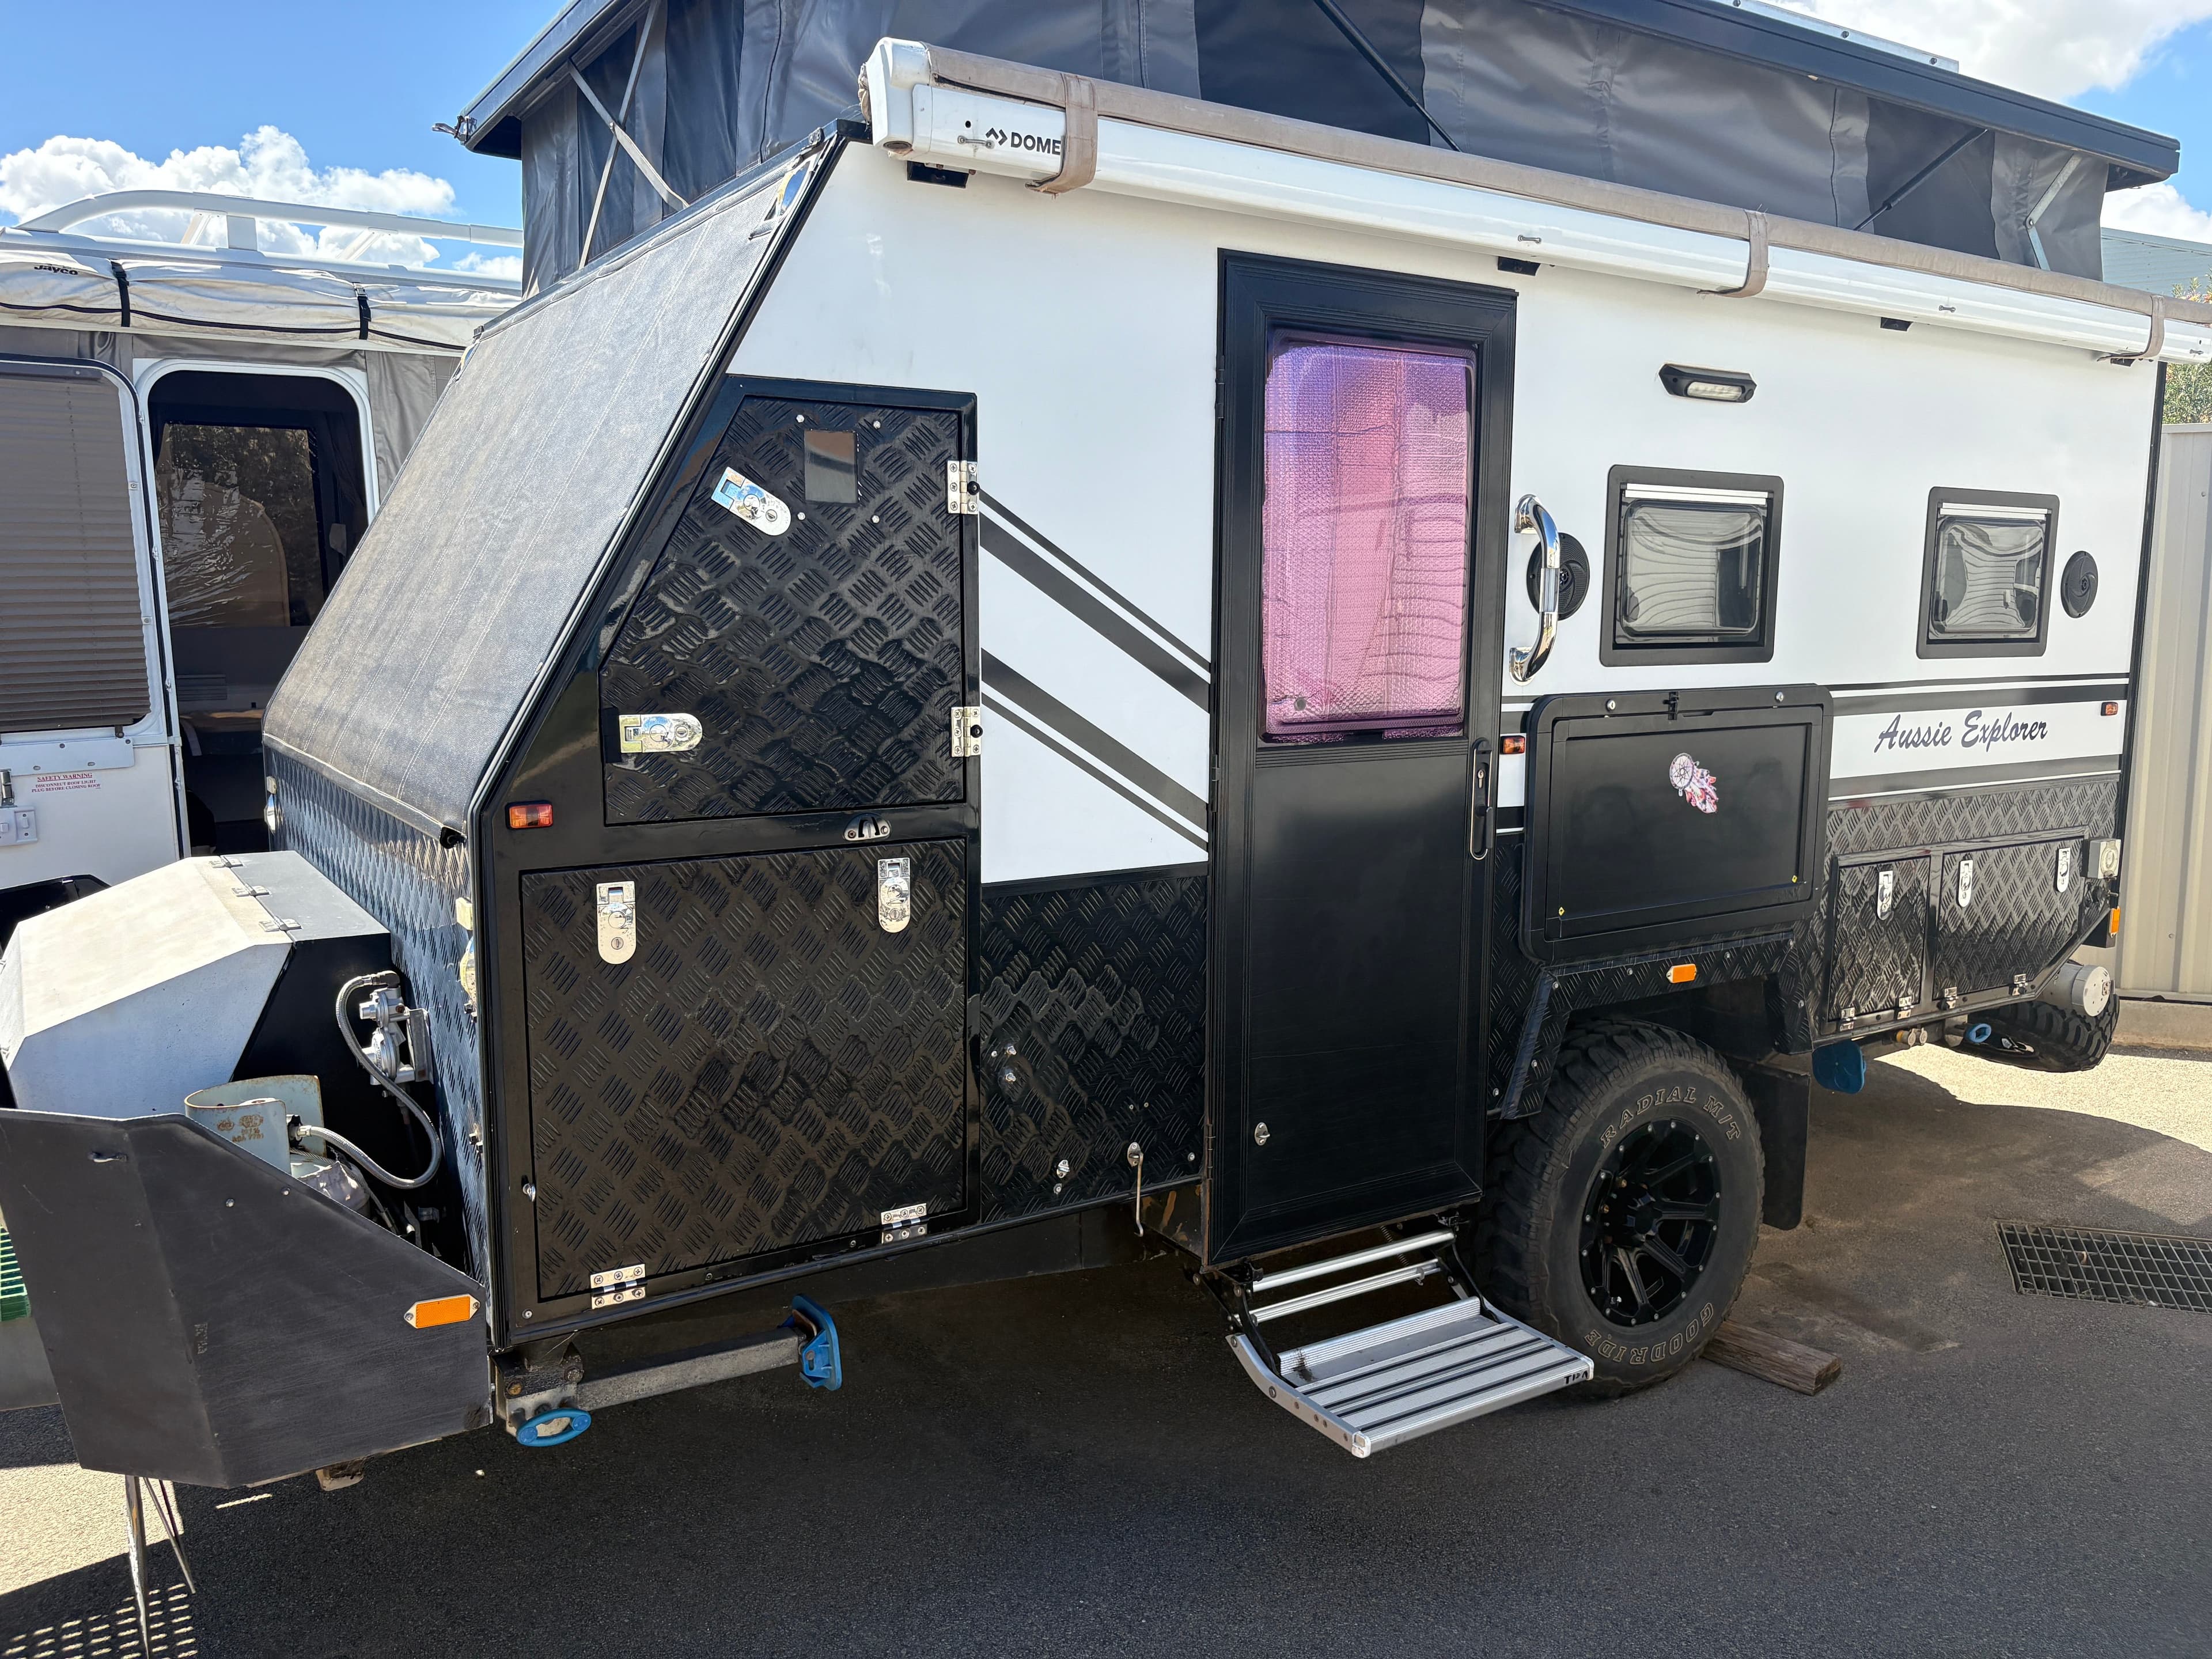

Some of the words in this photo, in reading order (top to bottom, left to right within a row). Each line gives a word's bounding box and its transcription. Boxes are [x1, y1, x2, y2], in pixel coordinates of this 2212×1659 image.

[34, 265, 78, 275] Jayco
[1874, 714, 1952, 753] Aussie
[1961, 710, 2048, 752] Explorer
[1600, 1086, 1696, 1149] RADIAL
[1703, 1096, 1741, 1140] M/T
[1584, 1302, 1714, 1365] GOODRIDE
